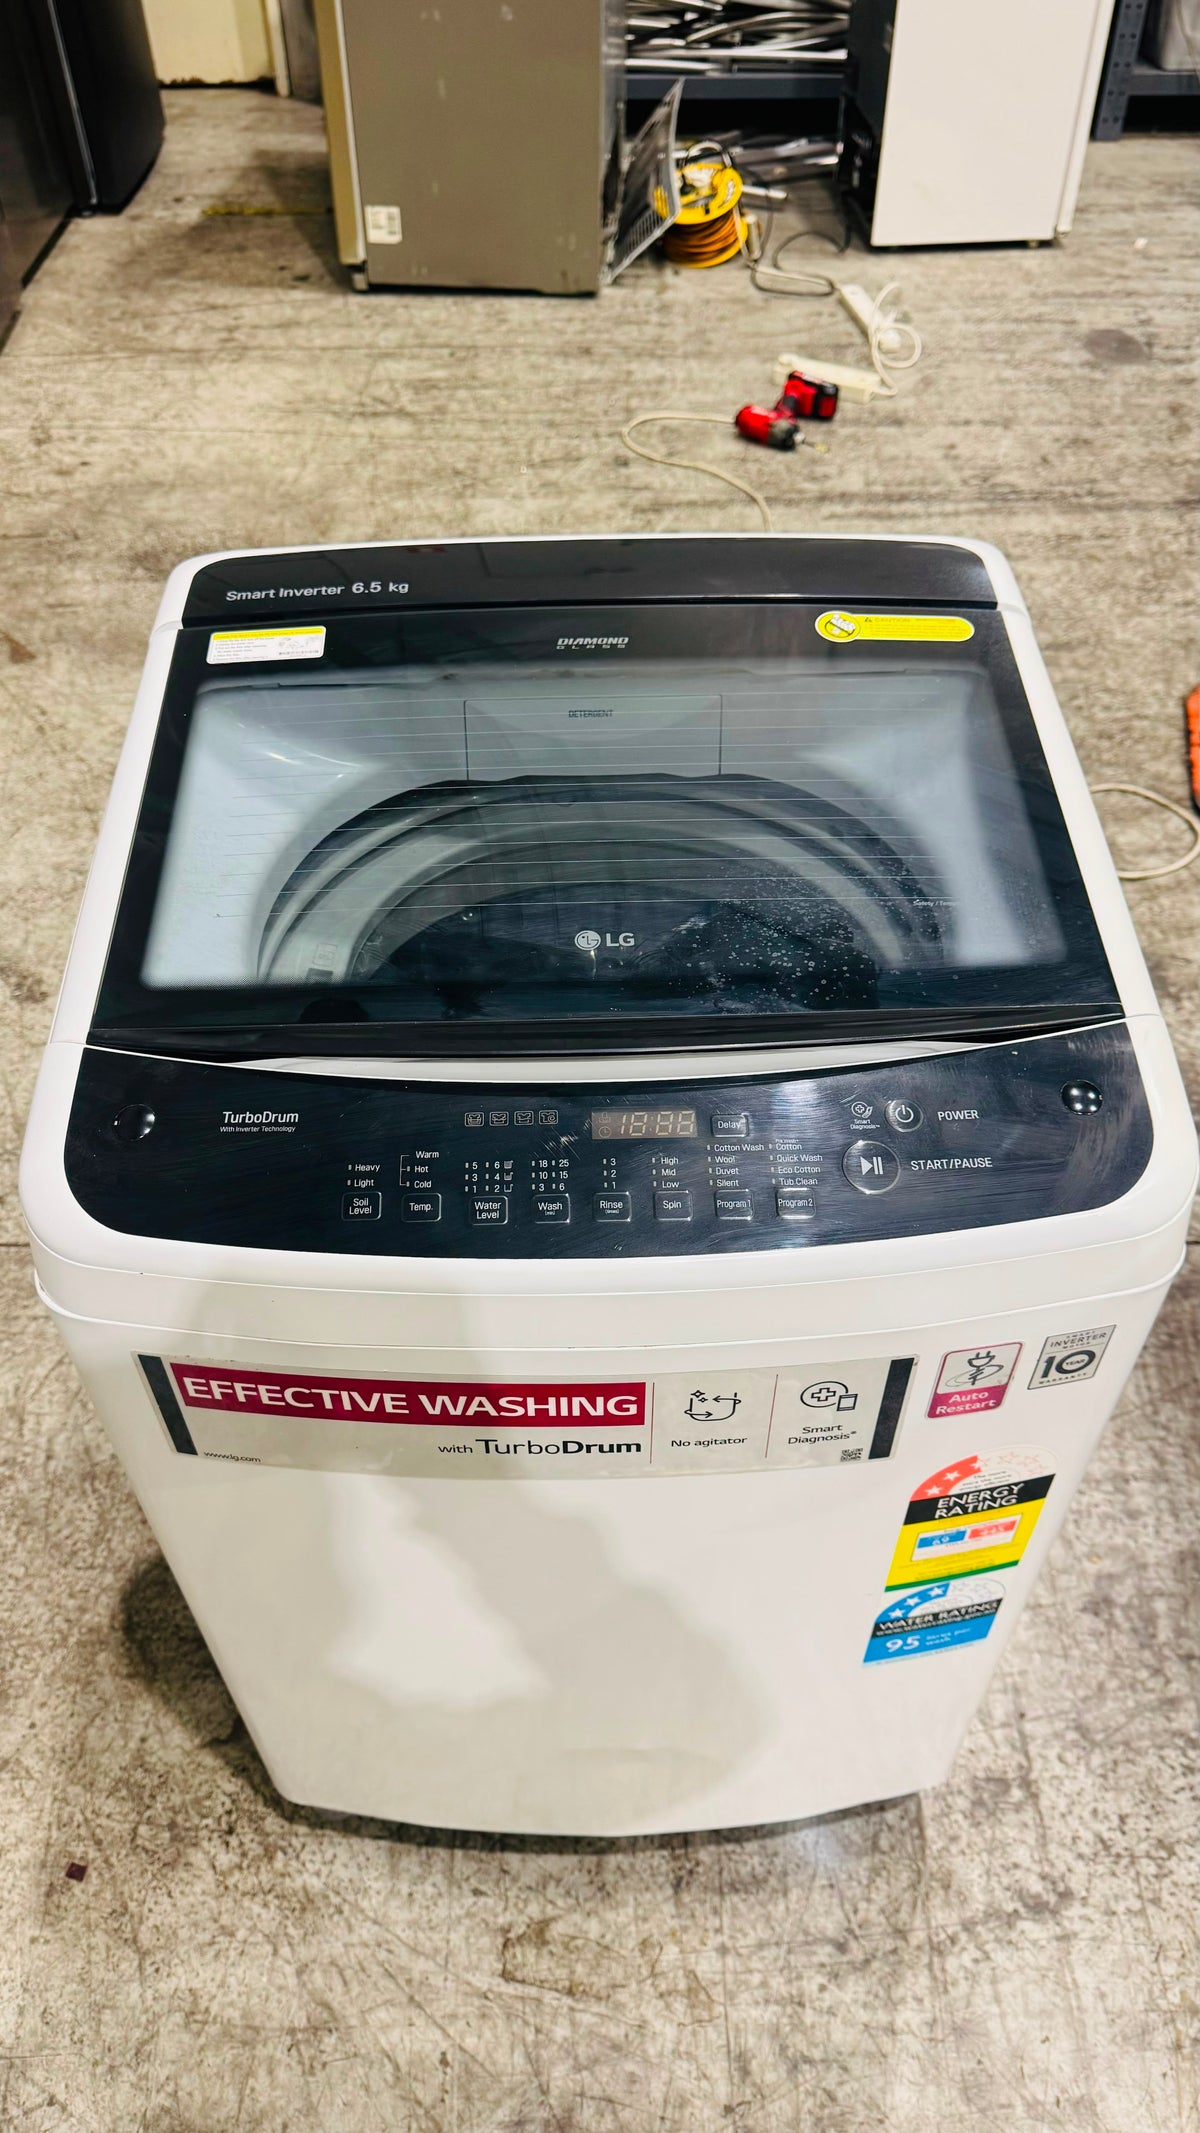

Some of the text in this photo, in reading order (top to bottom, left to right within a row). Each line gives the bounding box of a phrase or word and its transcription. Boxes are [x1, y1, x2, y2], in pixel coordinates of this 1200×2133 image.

[226, 581, 410, 602] Smart Inverter 6.5 kg
[557, 637, 629, 646] DIAMOND
[568, 709, 613, 718] DETERGENT
[605, 932, 635, 947] LG
[222, 1111, 299, 1124] TurboDrum
[937, 1109, 980, 1121] POWER
[261, 1125, 296, 1133] Technology
[717, 1120, 741, 1130] Delay
[714, 1143, 765, 1152] Cotton Wash
[775, 1143, 803, 1151] Cotton
[415, 1150, 440, 1159] Warm
[715, 1155, 736, 1164] Wool
[776, 1153, 823, 1163] Quick Wash
[472, 1161, 478, 1170] 5
[494, 1161, 500, 1170] 6
[538, 1159, 548, 1168] 18
[558, 1159, 570, 1168] 25
[610, 1158, 617, 1166] 3
[660, 1156, 679, 1165] High
[910, 1157, 993, 1171] START/PAUSE
[354, 1163, 381, 1173] Heavy
[414, 1165, 429, 1173] Hot
[661, 1167, 676, 1177] Mid
[715, 1167, 739, 1176] Duvet
[778, 1165, 821, 1174] Eco Cotton
[472, 1173, 478, 1182] 3
[494, 1173, 500, 1181] 4
[538, 1171, 548, 1180] 10
[559, 1171, 569, 1179] 15
[610, 1169, 617, 1178] 2
[354, 1178, 375, 1188] Light
[414, 1180, 432, 1189] Cold
[611, 1181, 616, 1190] 1
[661, 1180, 680, 1189] Low
[716, 1178, 740, 1188] Silent
[779, 1177, 819, 1186] Tub Clean
[473, 1185, 477, 1193] 1
[494, 1184, 500, 1193] 2
[538, 1183, 545, 1192] 3
[559, 1183, 565, 1191] 6
[353, 1197, 369, 1207] Soil
[474, 1201, 501, 1211] Water
[537, 1201, 563, 1211] Wash
[599, 1200, 623, 1209] Rinse
[663, 1200, 682, 1210] Spin
[716, 1199, 746, 1210] Program
[778, 1198, 813, 1209] Program 2
[349, 1205, 372, 1215] Level
[409, 1202, 433, 1213] Temp.
[476, 1210, 500, 1220] Level
[1050, 1332, 1107, 1347] INVERTER
[1041, 1350, 1096, 1379] 10
[182, 1376, 640, 1418] EFFECTIVE WASHING
[948, 1389, 990, 1404] Auto
[935, 1398, 996, 1416] Restart
[802, 1425, 843, 1435] Smart
[438, 1439, 642, 1456] with TurboDrum
[671, 1435, 748, 1450] No agitator
[937, 1482, 1025, 1509] ENERGY
[934, 1495, 1018, 1519] RATING
[938, 1601, 999, 1620] RATING
[879, 1614, 934, 1631] WATER
[885, 1634, 921, 1653] 95
